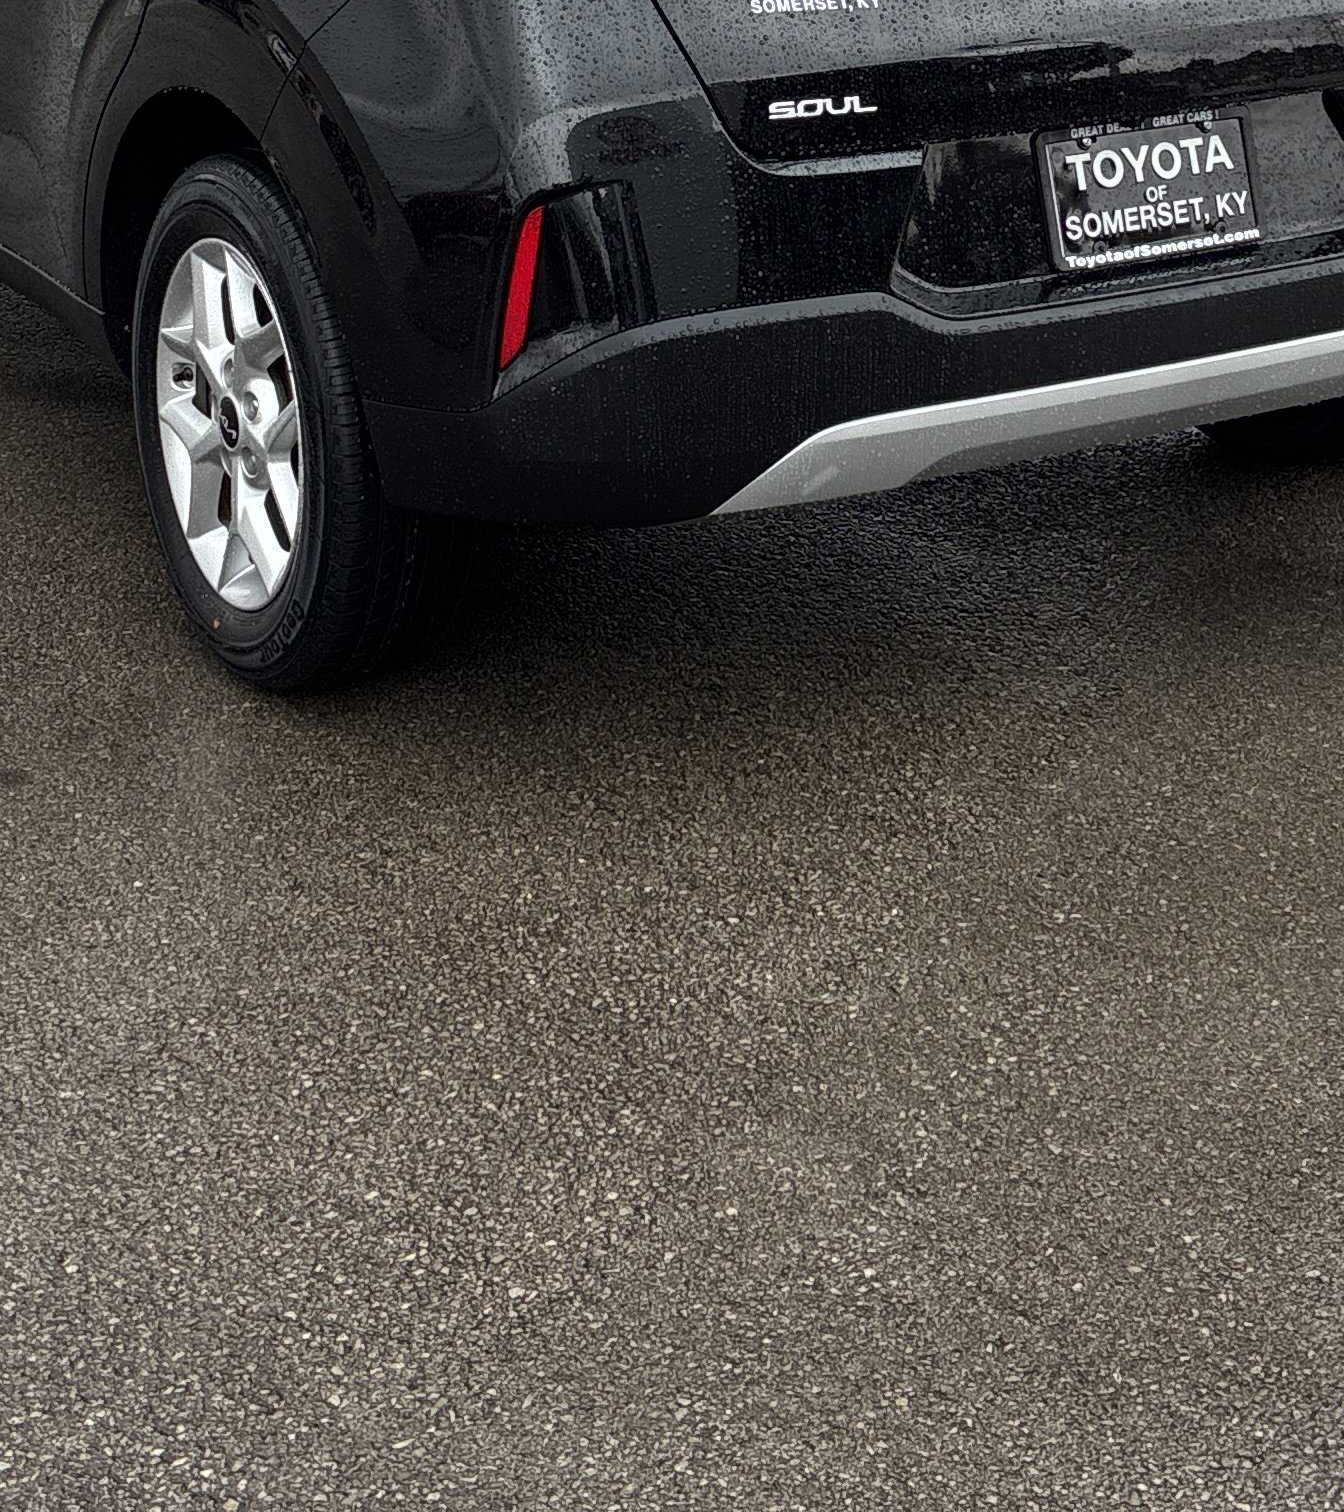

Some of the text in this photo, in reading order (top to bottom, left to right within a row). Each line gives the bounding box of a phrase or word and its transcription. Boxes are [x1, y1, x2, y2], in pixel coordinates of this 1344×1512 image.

[768, 95, 878, 120] SOUL
[1071, 124, 1104, 138] GREAT
[1152, 113, 1184, 127] GREAT
[1065, 135, 1234, 192] TOYOTA
[1145, 185, 1168, 203] OF
[1065, 191, 1248, 241] SOMERSET, KY
[1065, 228, 1260, 268] ToyotaofSomerset.com
